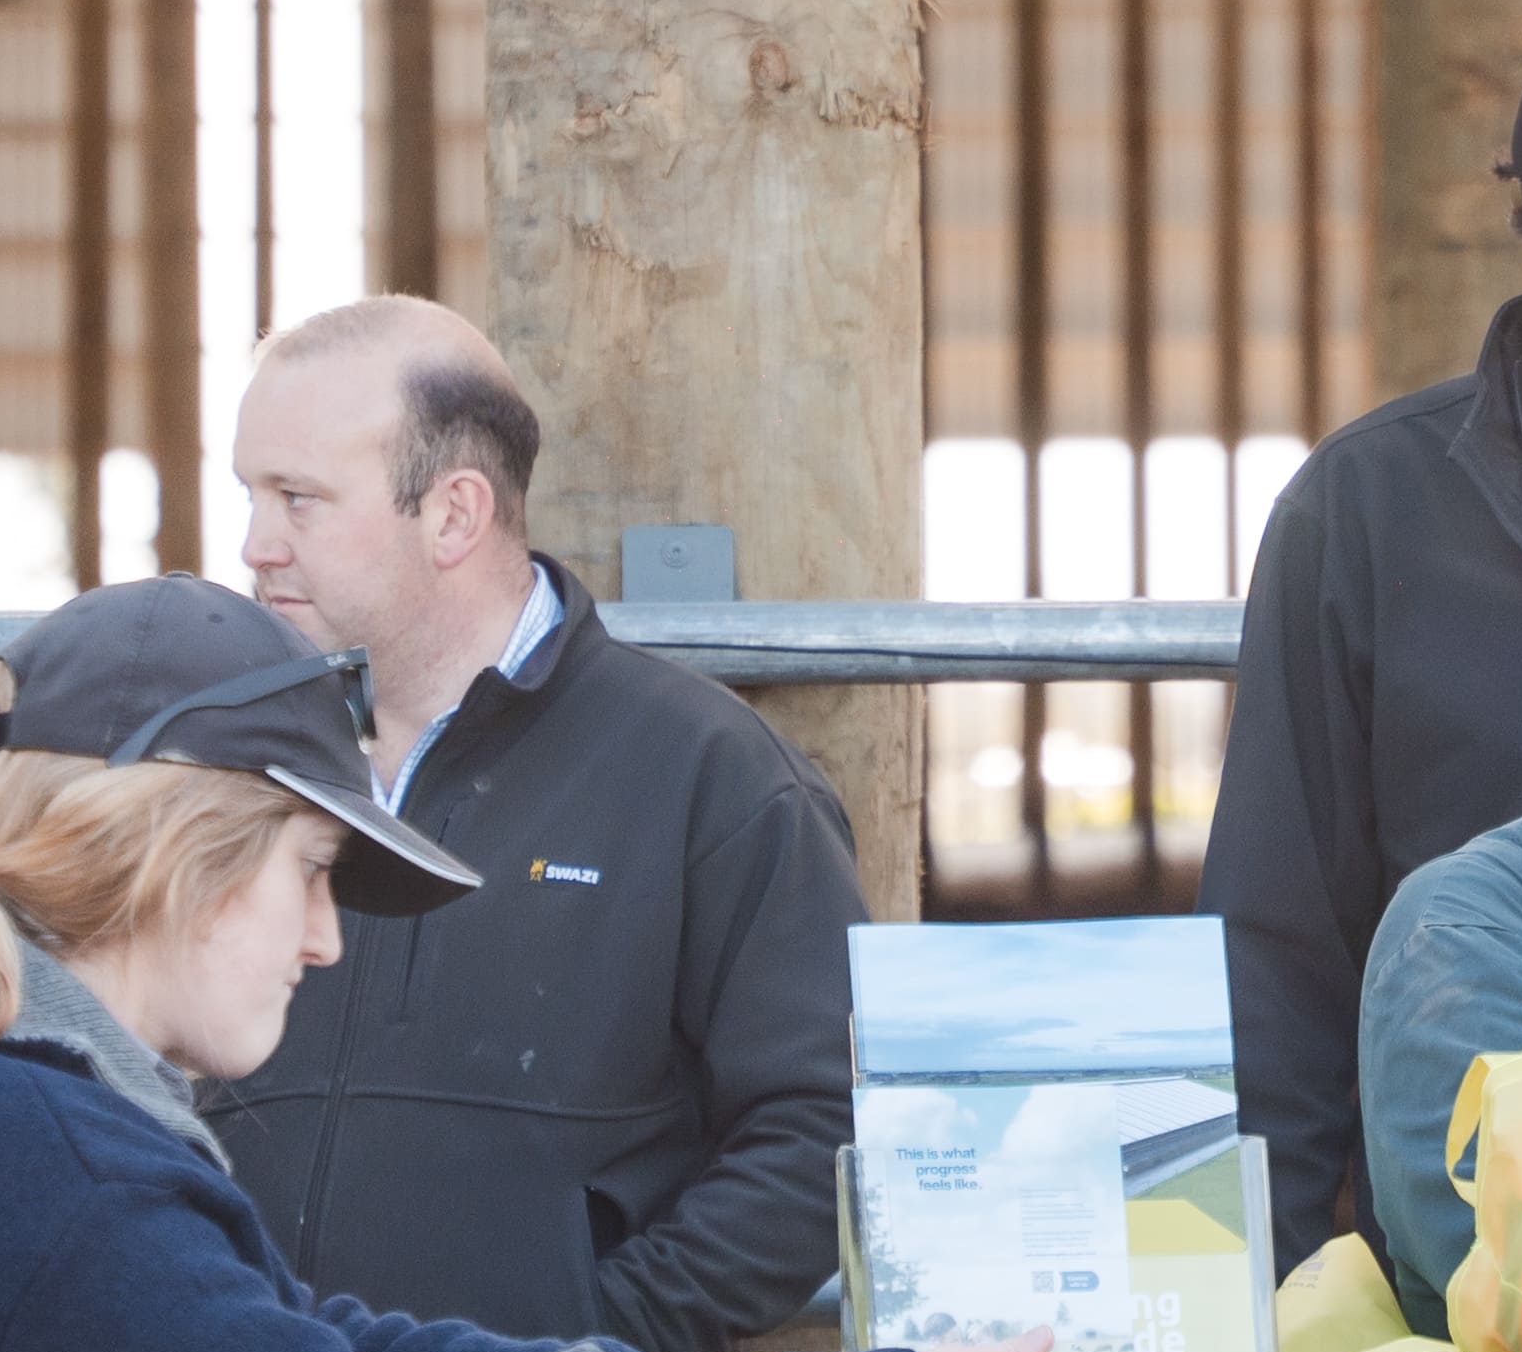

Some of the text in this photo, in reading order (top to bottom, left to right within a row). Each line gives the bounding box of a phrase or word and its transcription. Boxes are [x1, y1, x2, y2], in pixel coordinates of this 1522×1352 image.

[545, 863, 600, 885] SWAZI
[895, 1147, 976, 1160] This is what
[916, 1164, 977, 1179] progress
[919, 1178, 983, 1192] feels like.
